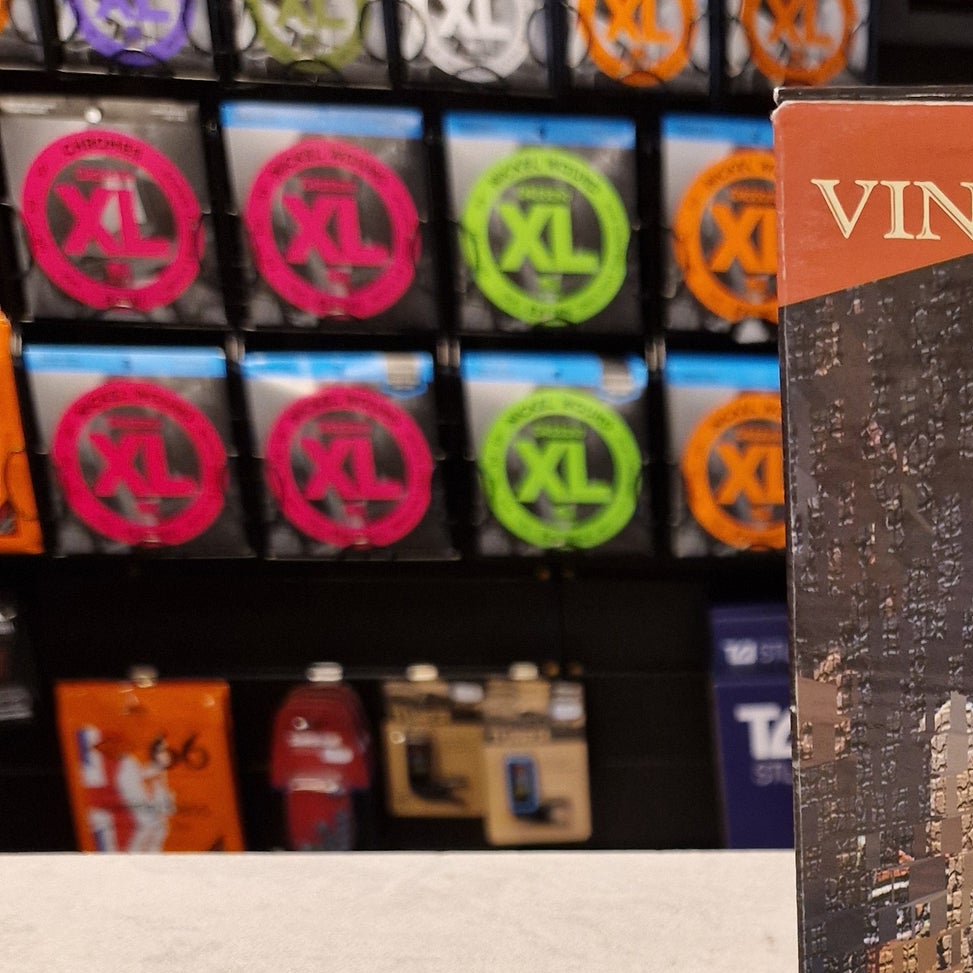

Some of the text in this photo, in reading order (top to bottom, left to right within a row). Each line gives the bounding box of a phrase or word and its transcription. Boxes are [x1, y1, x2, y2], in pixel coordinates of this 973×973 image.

[54, 184, 173, 257] XL
[282, 195, 393, 265] XL
[496, 204, 599, 273] XL
[89, 432, 198, 498] XL
[301, 437, 406, 500] XL
[515, 440, 613, 502] XL
